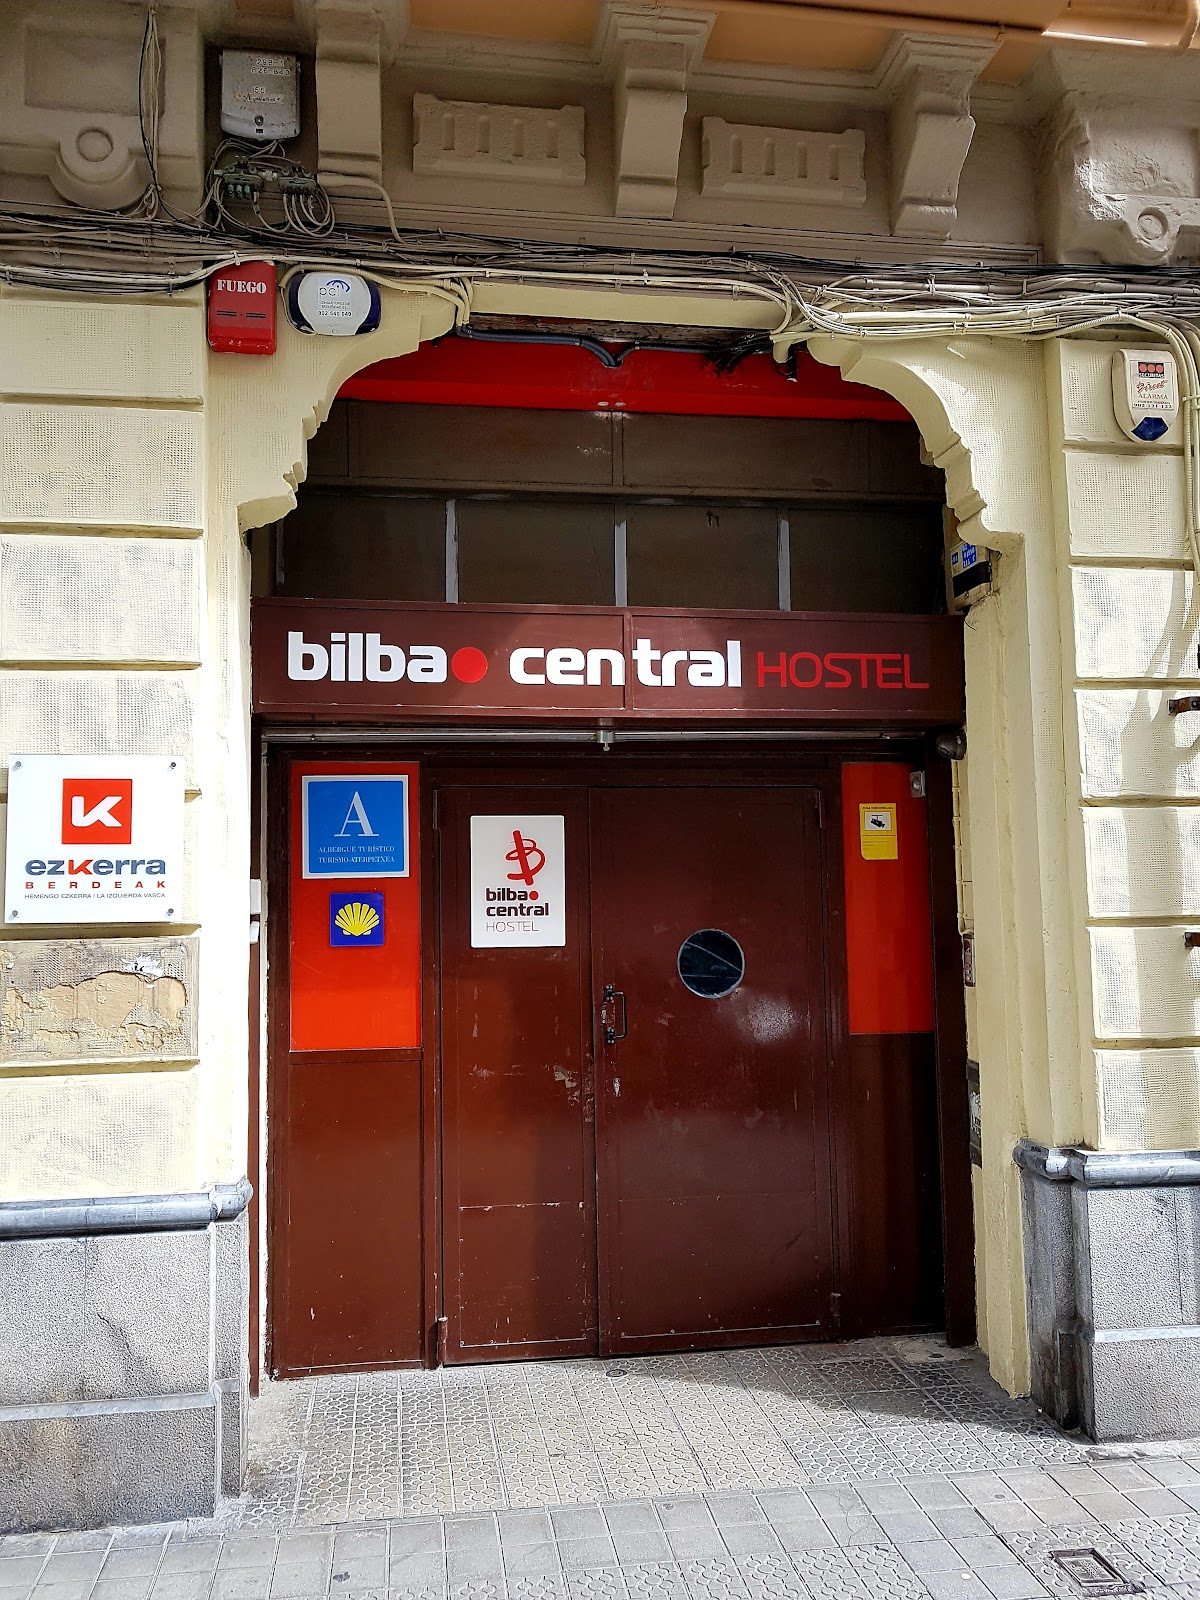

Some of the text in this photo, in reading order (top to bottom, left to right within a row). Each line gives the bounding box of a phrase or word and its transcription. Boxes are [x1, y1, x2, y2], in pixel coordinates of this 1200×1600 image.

[217, 279, 267, 294] FUEGO
[319, 285, 341, 298] pci
[509, 639, 741, 688] central
[757, 652, 929, 689] HOSTEL
[333, 791, 380, 837] A
[357, 844, 395, 852] TURÍSTICO
[317, 856, 395, 864] TURISMO-ATERPETXEA
[486, 903, 549, 916] central
[485, 921, 540, 932] HOSTEL
